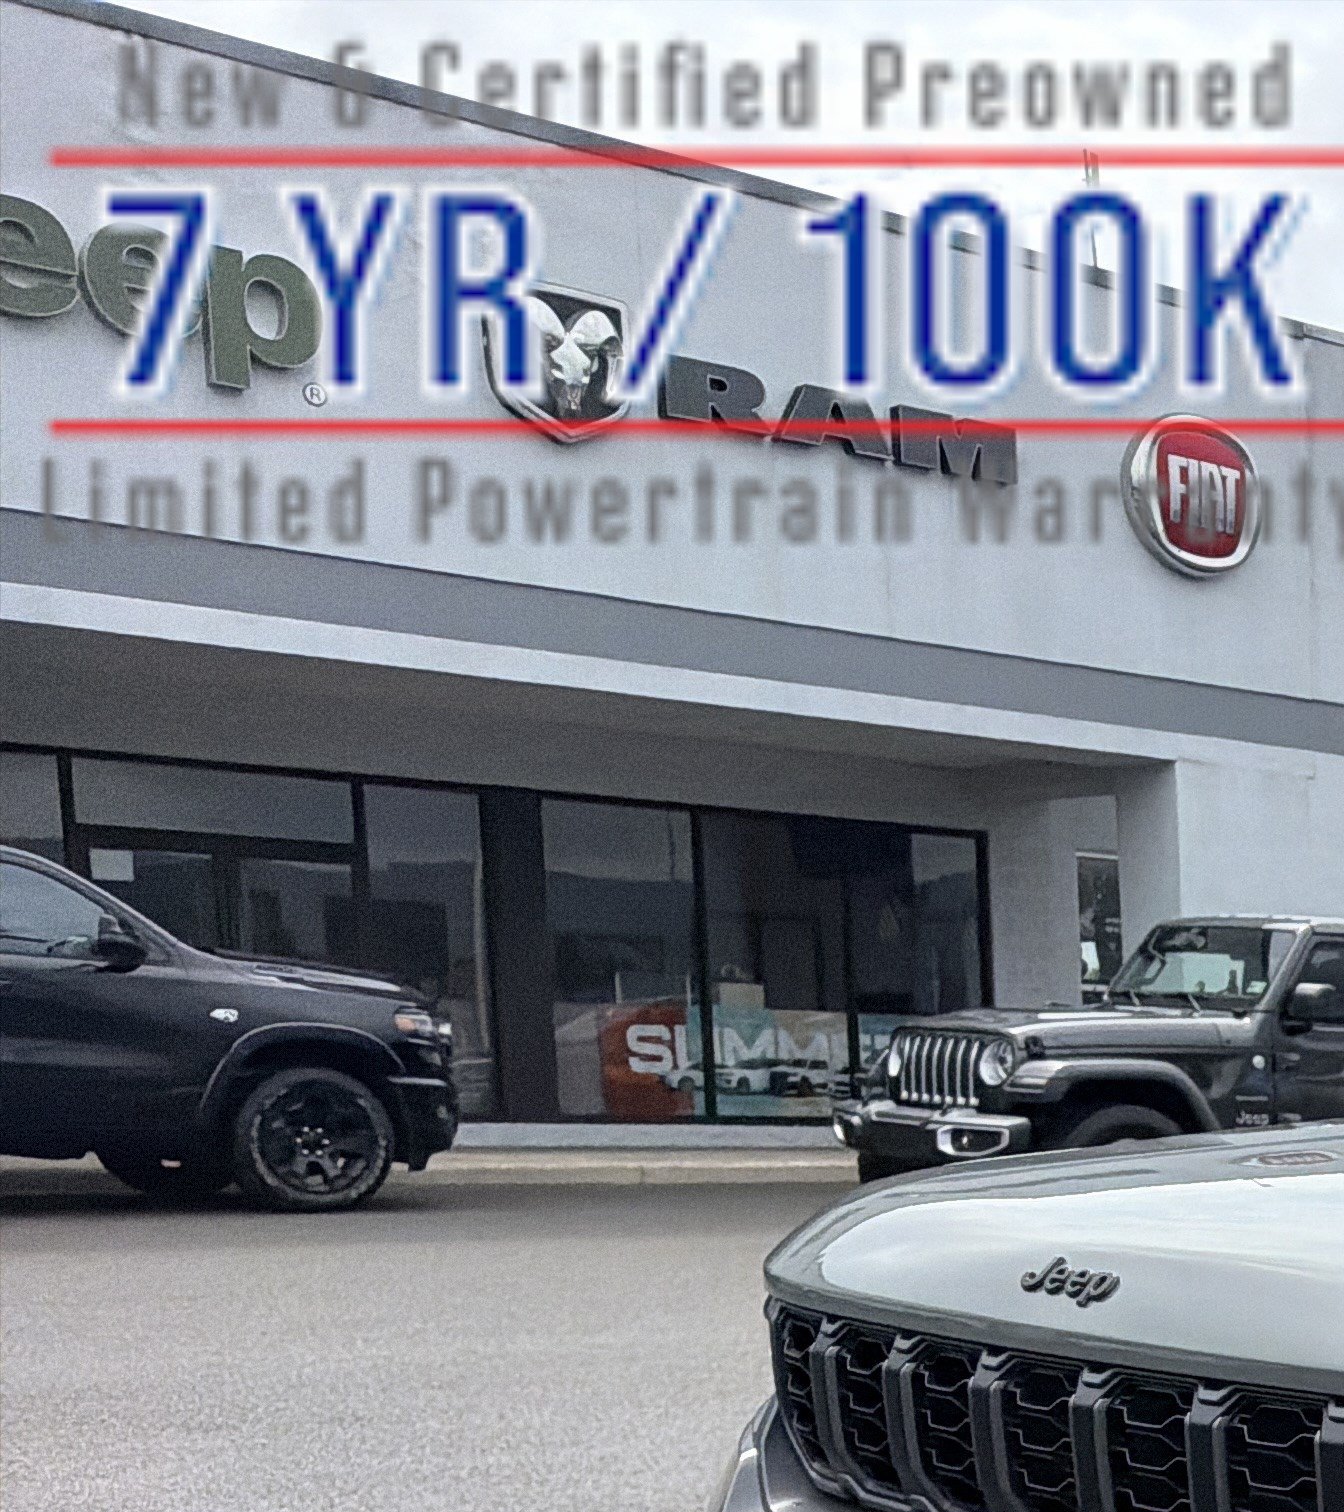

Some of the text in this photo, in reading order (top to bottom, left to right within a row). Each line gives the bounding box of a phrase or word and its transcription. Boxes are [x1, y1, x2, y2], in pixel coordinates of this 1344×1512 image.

[0, 194, 322, 388] eep
[658, 354, 1017, 486] RAM
[1168, 454, 1241, 535] FIAT
[1020, 1256, 1120, 1309] Jeep
